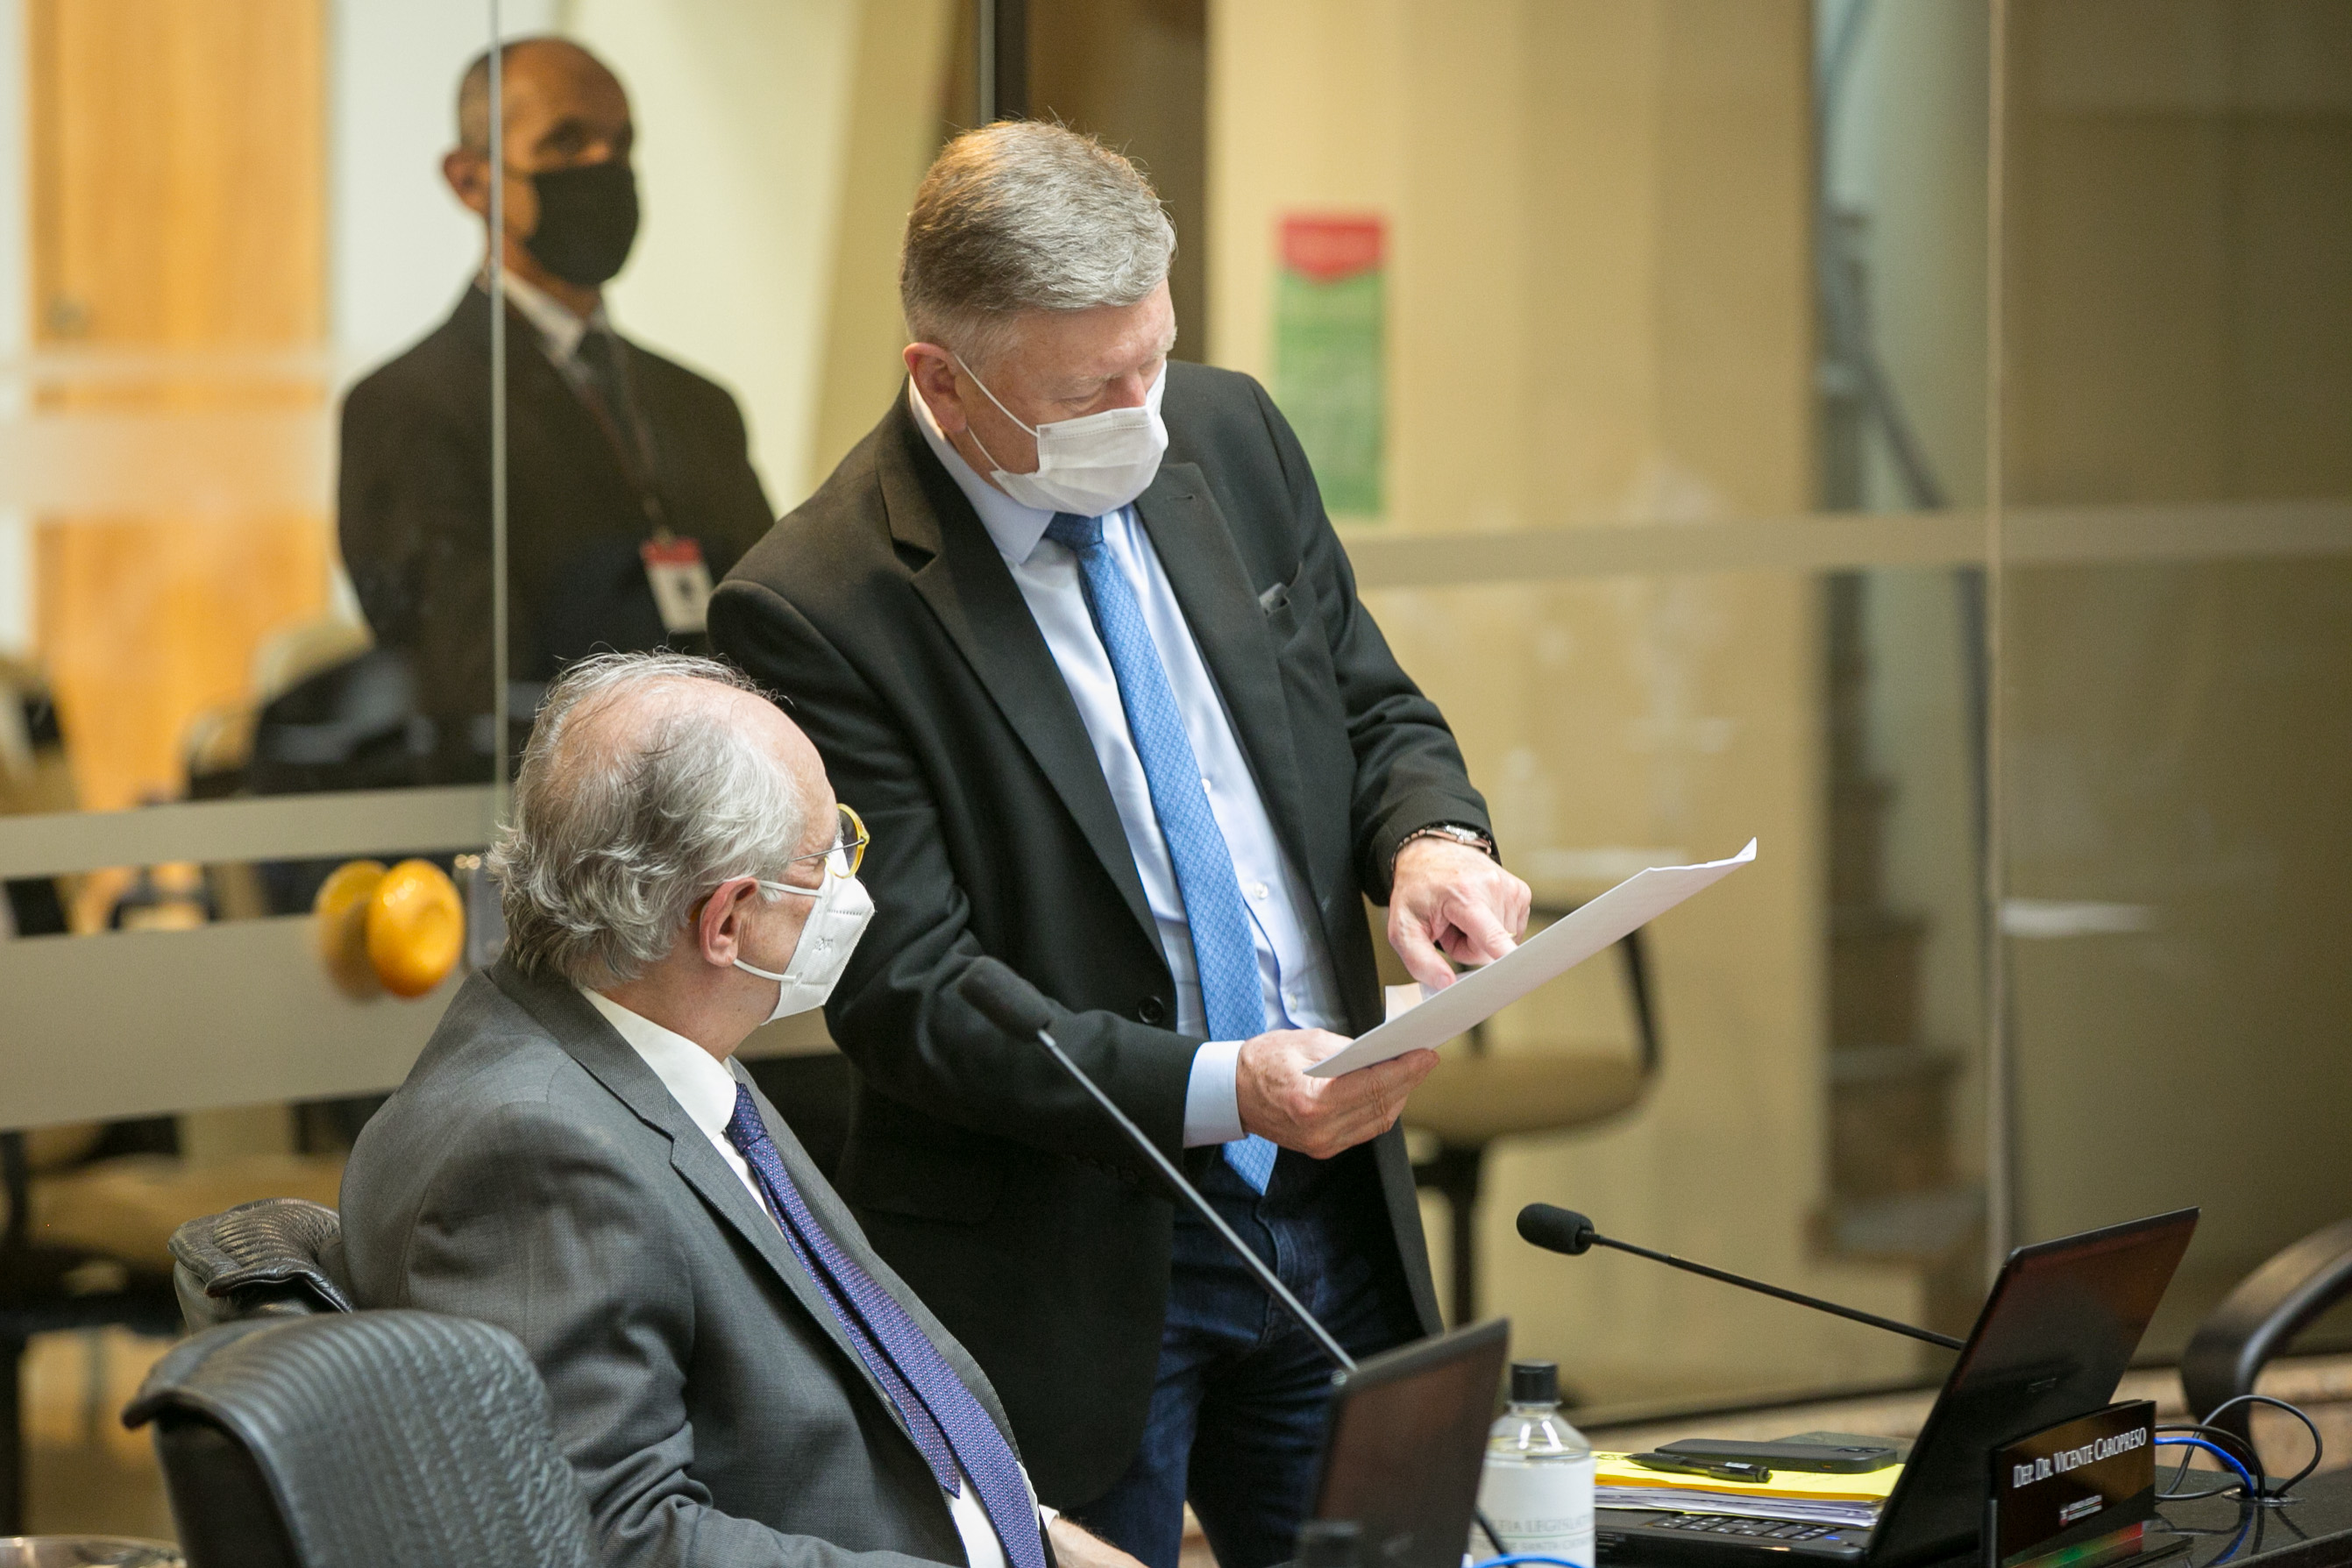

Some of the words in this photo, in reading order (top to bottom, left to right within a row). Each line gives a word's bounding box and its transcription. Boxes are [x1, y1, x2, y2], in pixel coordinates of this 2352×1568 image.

[2035, 1458, 2054, 1481] DR.
[2053, 1444, 2094, 1473] VICENTE
[2093, 1427, 2147, 1461] CAROPRESO
